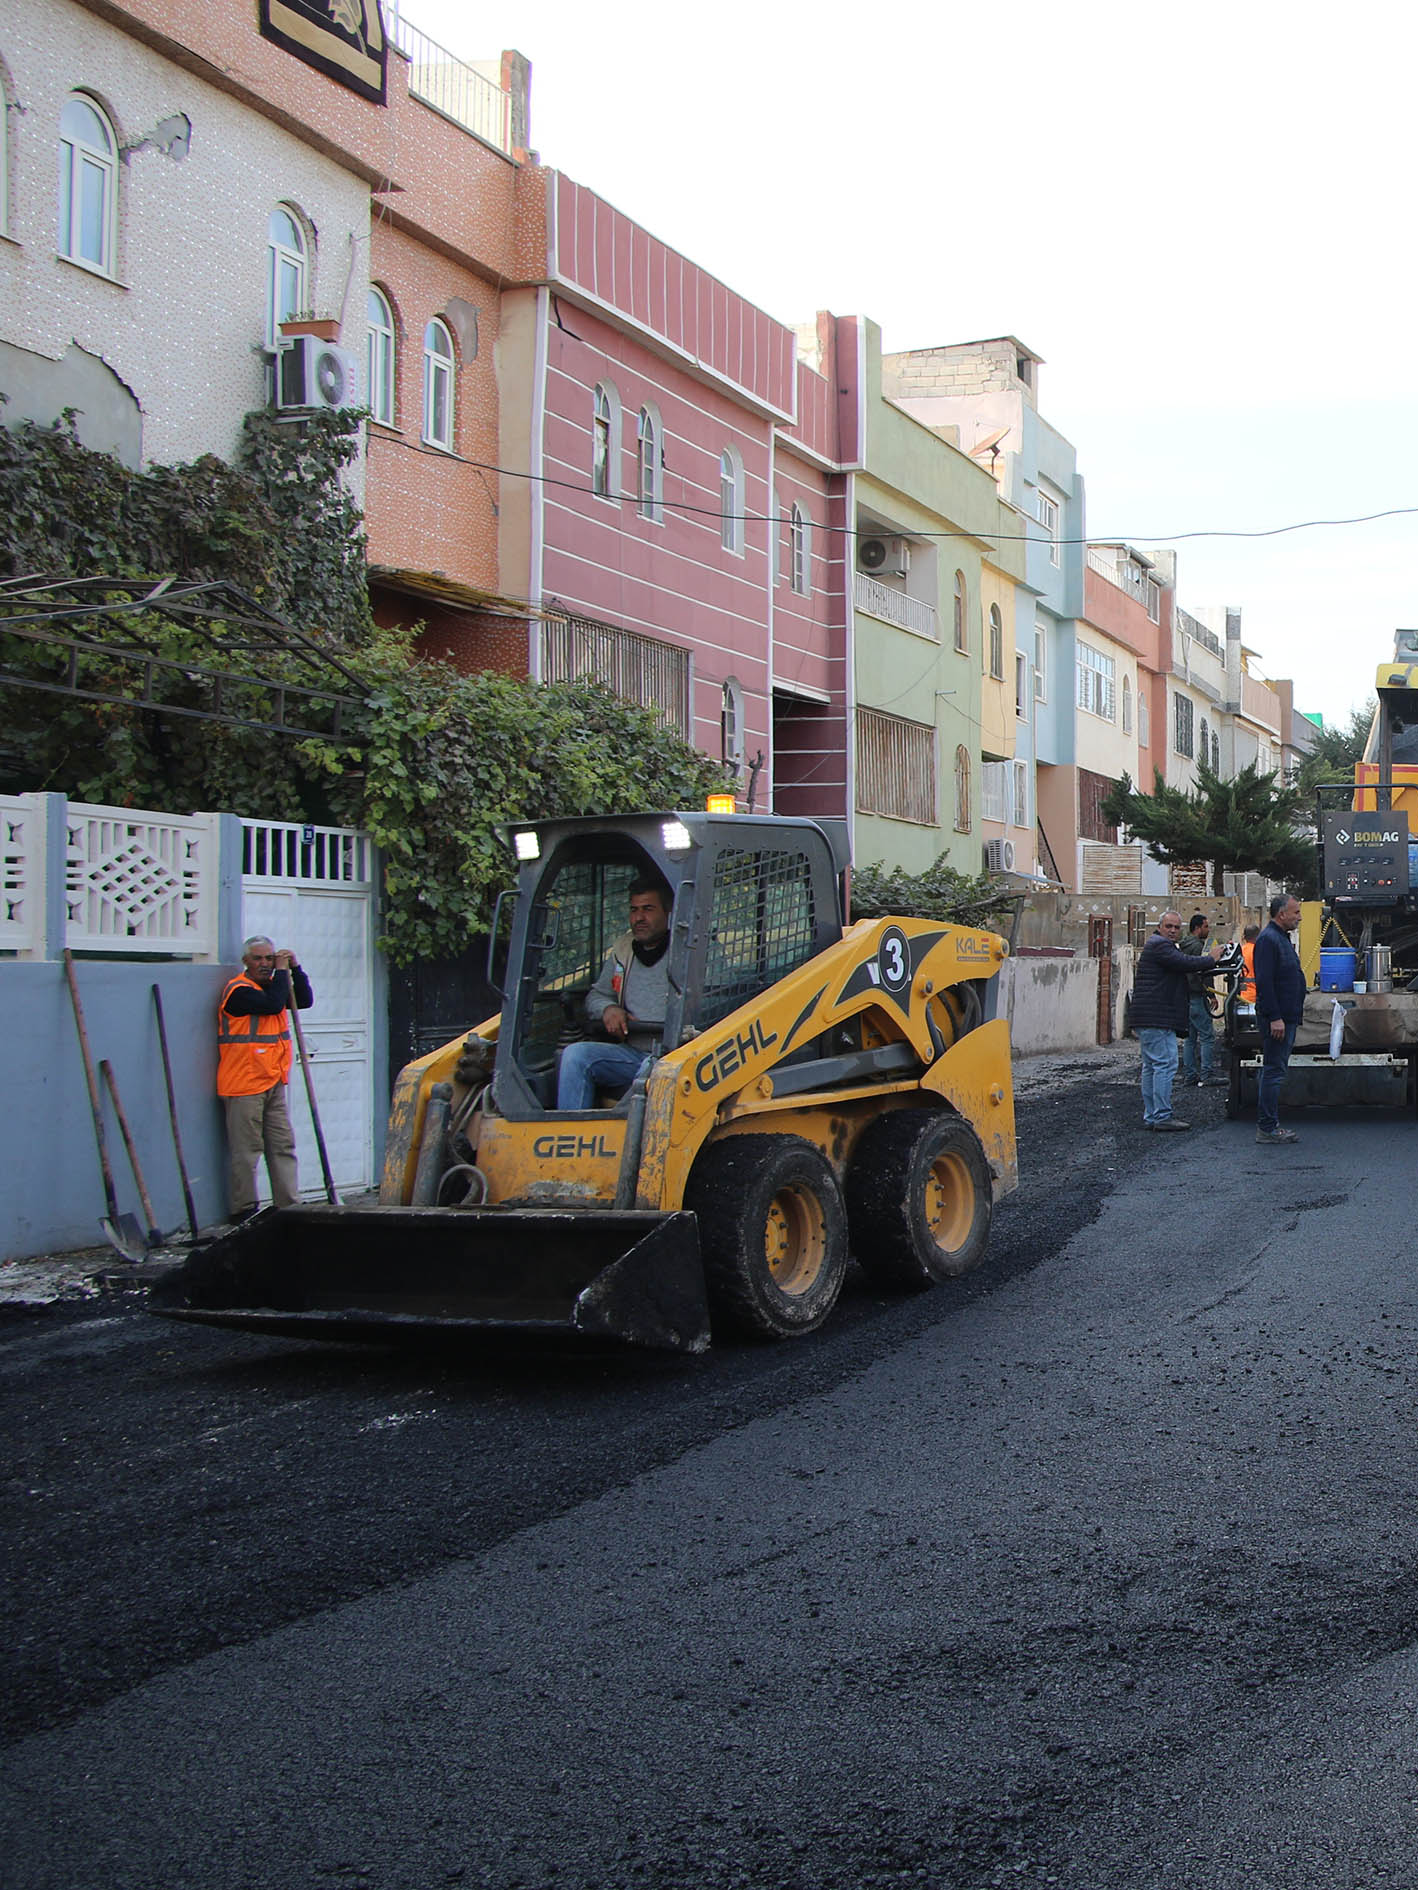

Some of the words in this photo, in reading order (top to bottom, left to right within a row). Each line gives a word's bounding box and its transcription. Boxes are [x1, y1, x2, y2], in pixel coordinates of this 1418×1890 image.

[1354, 831, 1399, 842] BOMAG
[955, 936, 990, 955] KALE
[885, 937, 905, 982] 3
[695, 1018, 778, 1092] GEHL
[533, 1136, 617, 1158] GEHL
